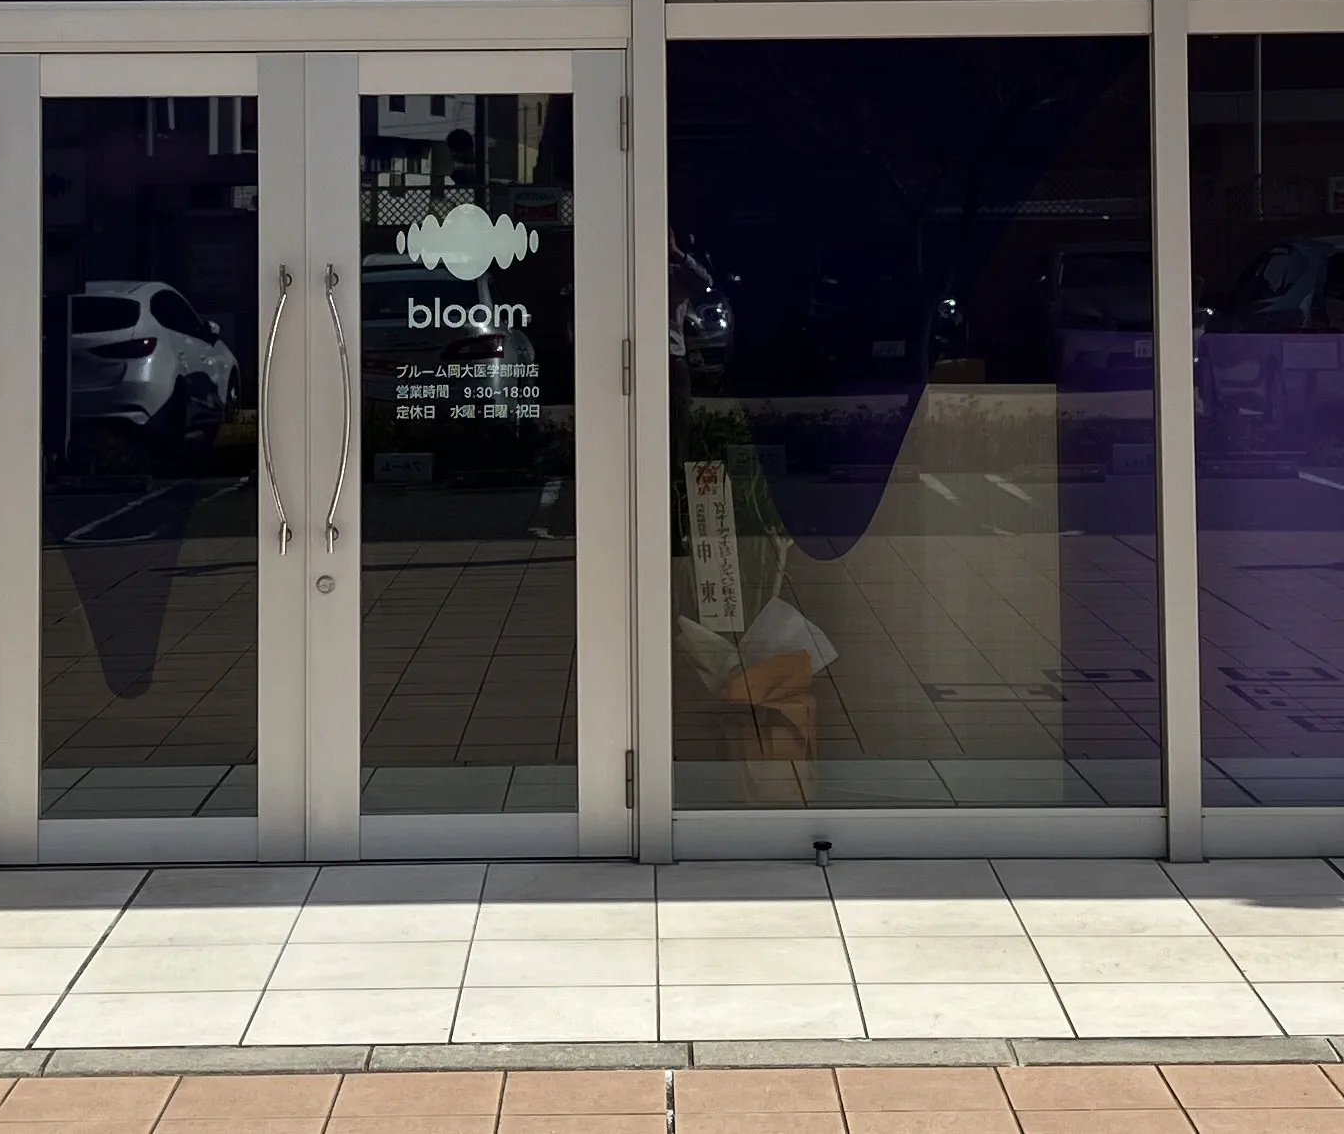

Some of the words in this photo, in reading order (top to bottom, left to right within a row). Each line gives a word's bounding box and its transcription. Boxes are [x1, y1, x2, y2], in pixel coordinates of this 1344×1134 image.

[408, 297, 528, 329] bloom
[396, 364, 539, 378] ブルーム岡大医学部前店
[396, 385, 449, 399] 営業時間
[396, 405, 435, 419] 定休日
